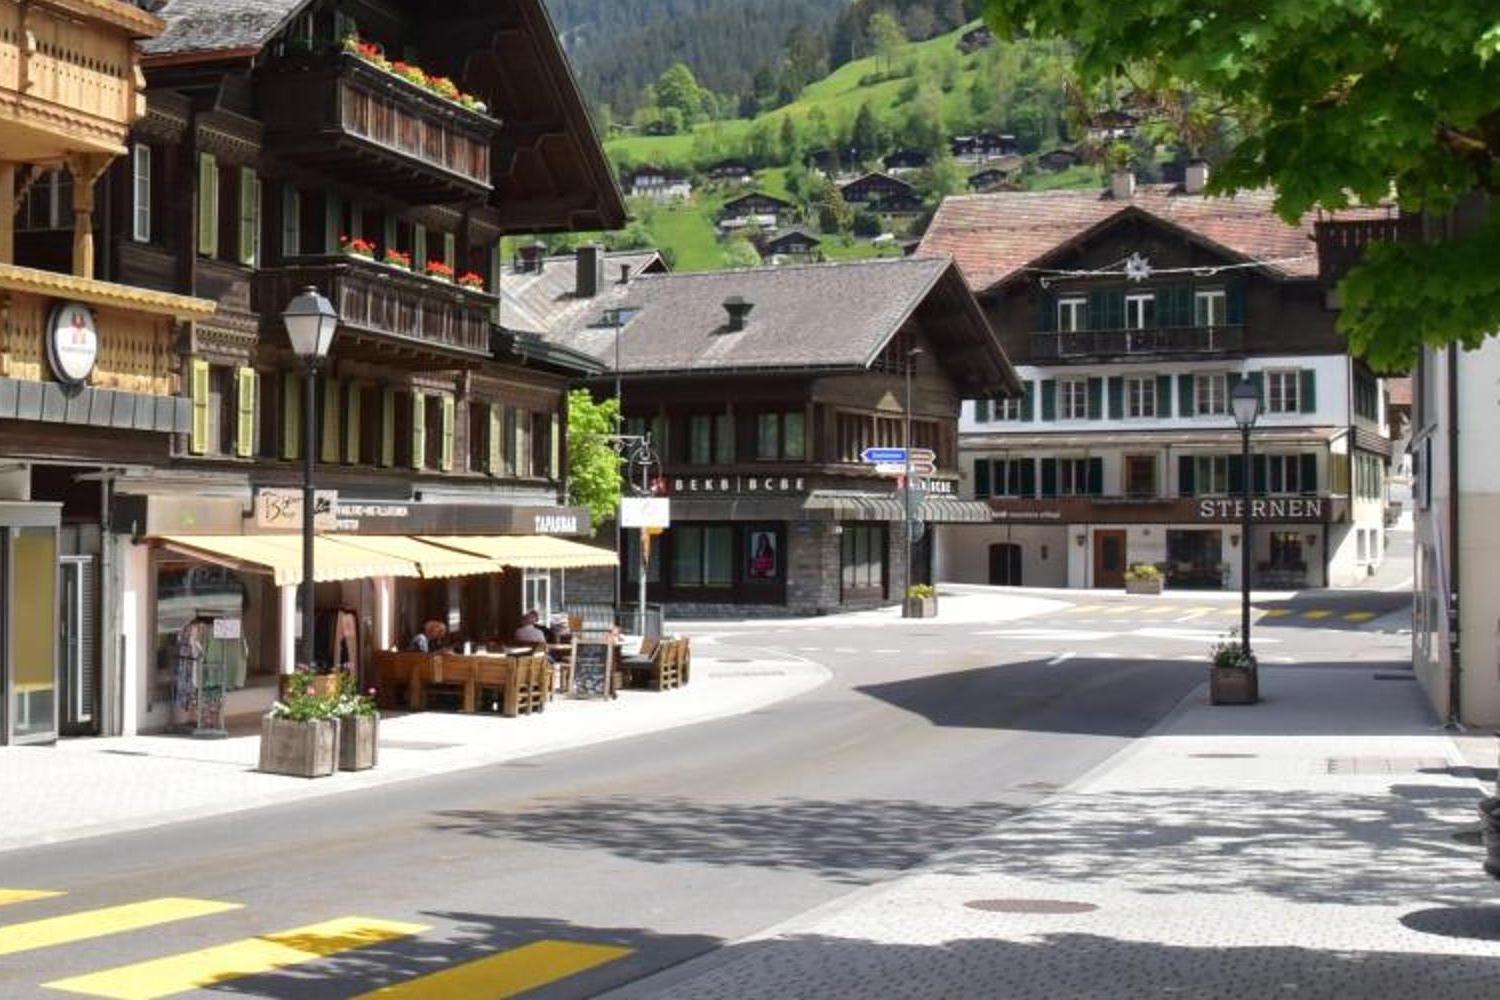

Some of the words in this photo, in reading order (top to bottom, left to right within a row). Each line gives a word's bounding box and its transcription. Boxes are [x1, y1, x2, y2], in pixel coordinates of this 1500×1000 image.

[675, 477, 729, 491] BEKB
[749, 477, 805, 491] BCBE
[1201, 499, 1322, 518] STERNEN
